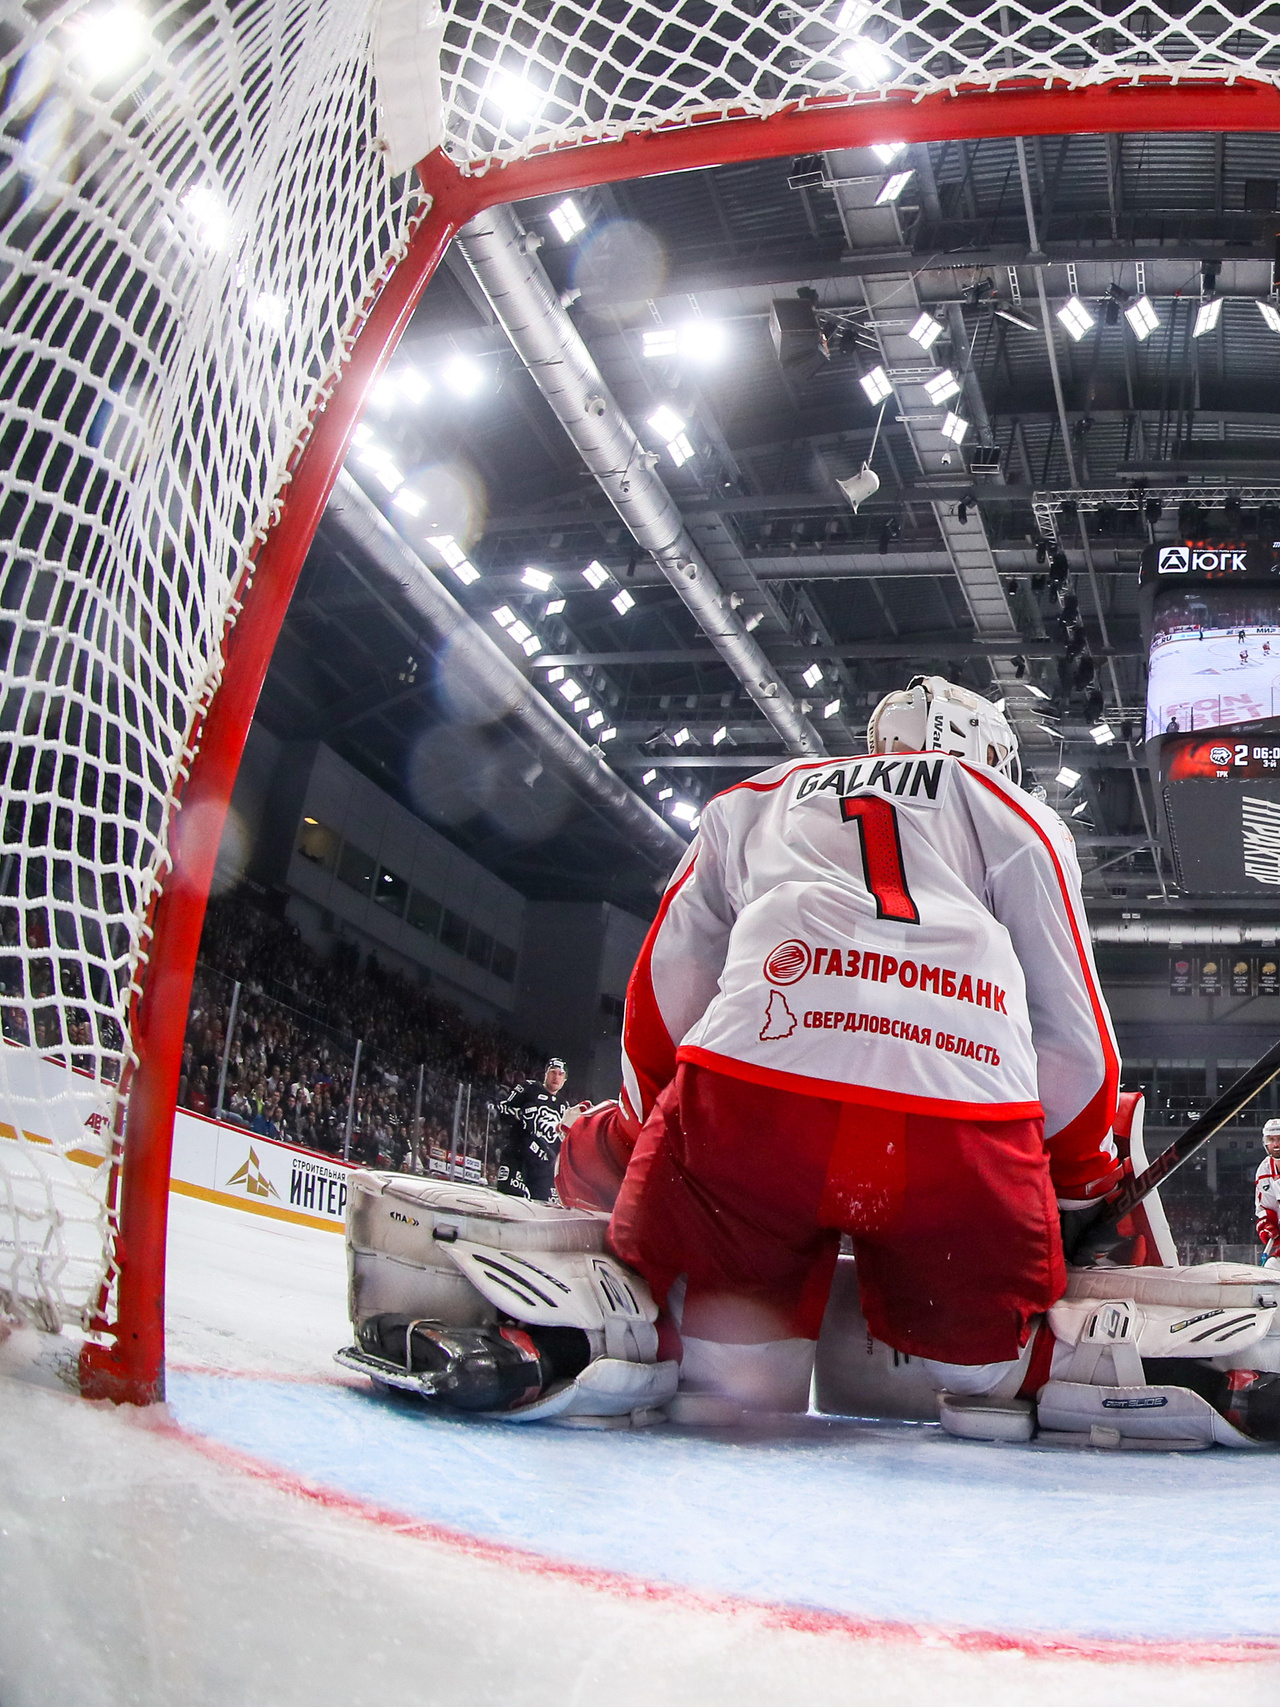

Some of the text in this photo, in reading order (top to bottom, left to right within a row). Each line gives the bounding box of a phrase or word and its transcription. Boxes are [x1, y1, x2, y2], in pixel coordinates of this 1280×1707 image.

[1192, 553, 1247, 571] ЮГК
[1234, 745, 1249, 766] 2
[796, 759, 944, 801] GALKIN
[838, 795, 921, 926] 1
[811, 948, 1009, 1016] ГАЗПРОМБАНК
[803, 1010, 1001, 1067] СВЕРДЛОВСКАЯ ОБЛАСТЬ
[292, 1158, 346, 1182] СТРОИТЕЛЬНАЯ
[289, 1169, 348, 1216] ИНТЕР
